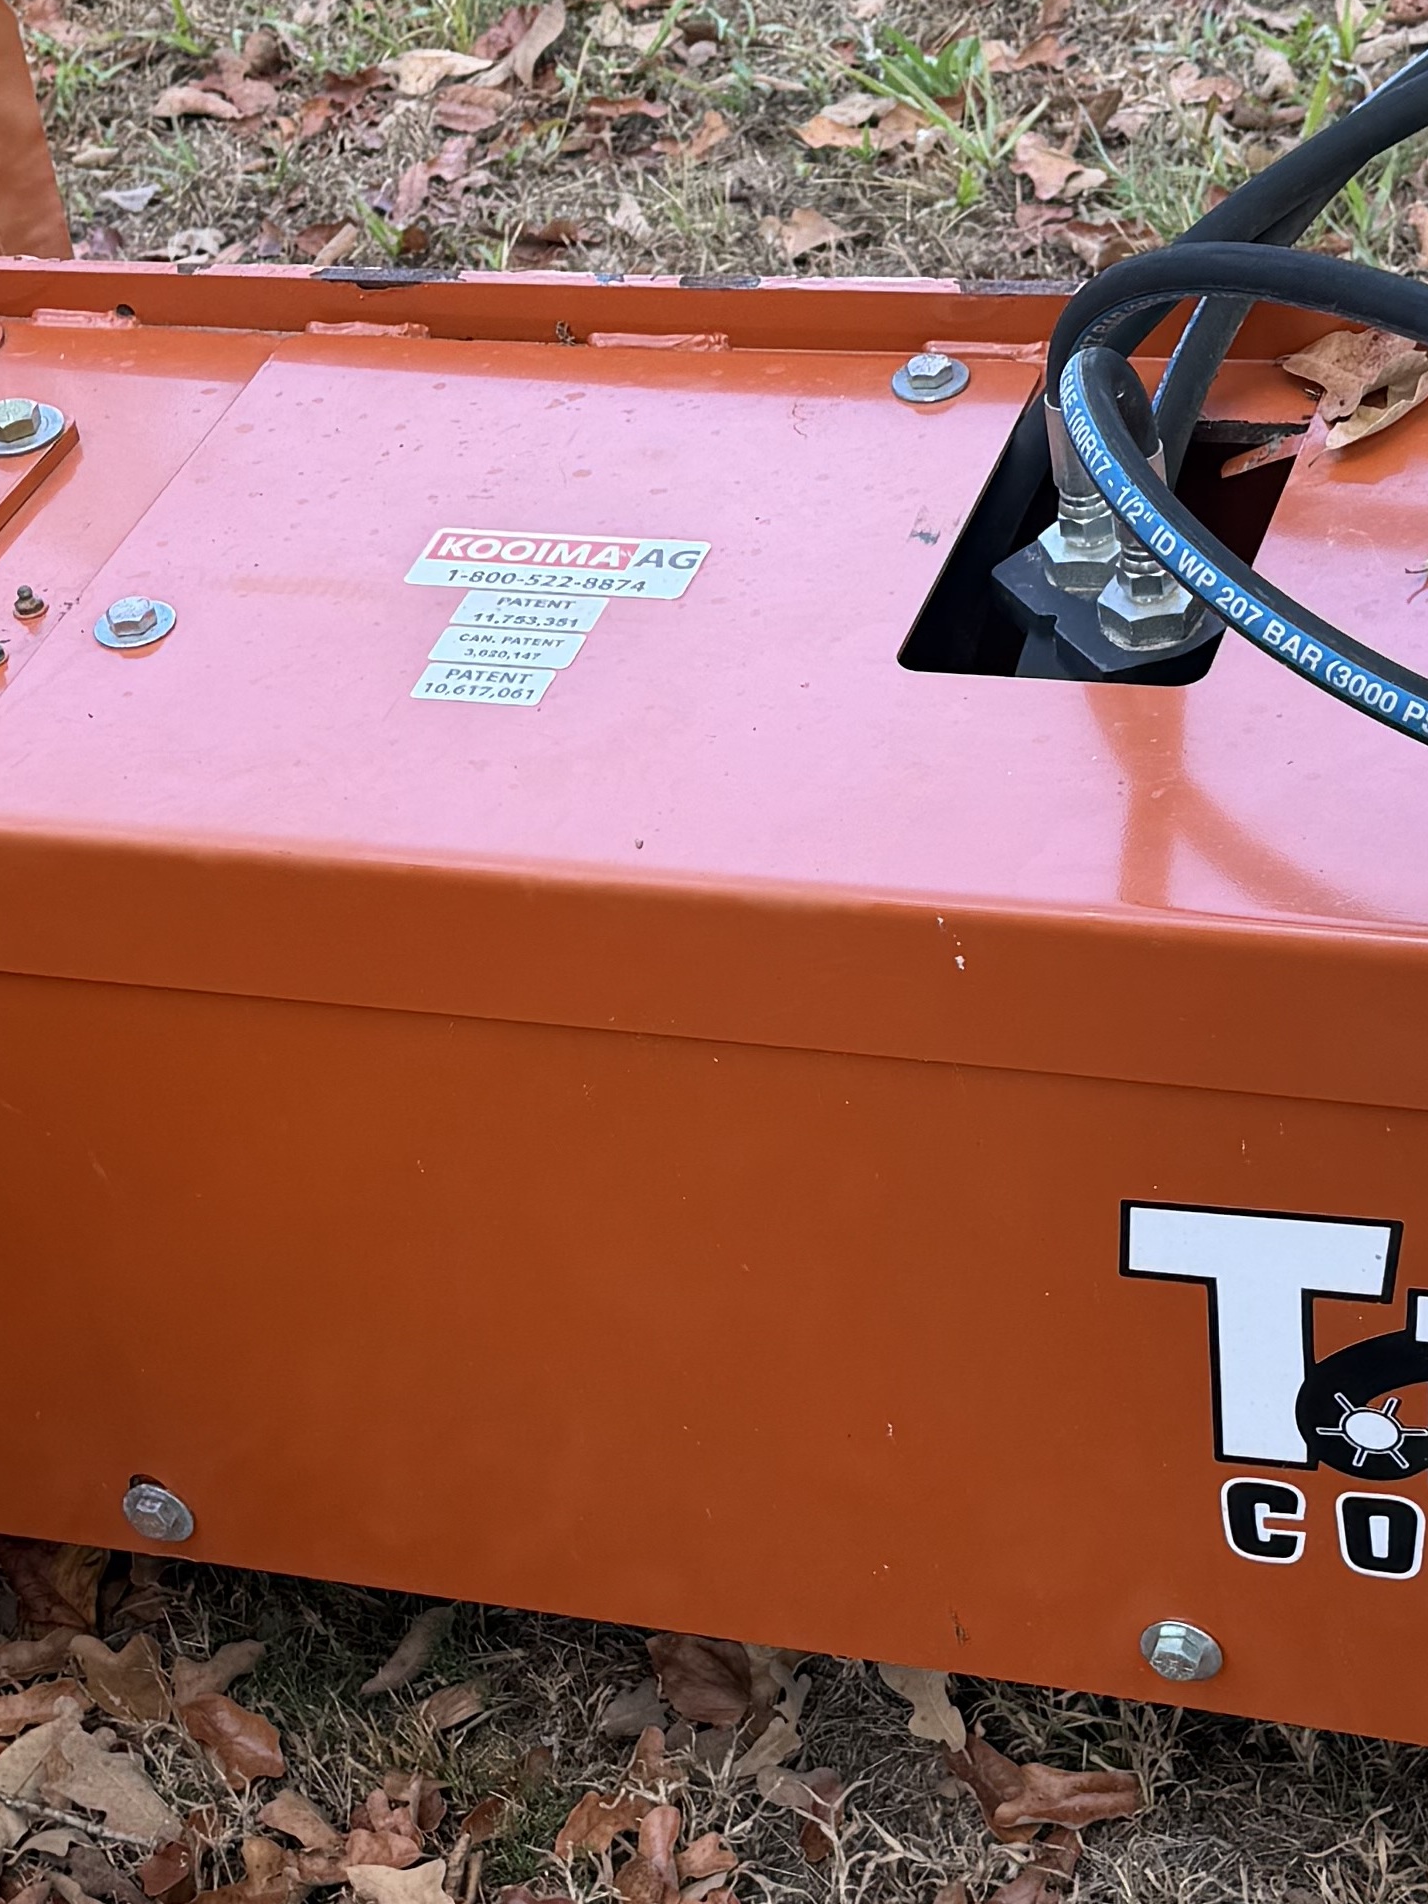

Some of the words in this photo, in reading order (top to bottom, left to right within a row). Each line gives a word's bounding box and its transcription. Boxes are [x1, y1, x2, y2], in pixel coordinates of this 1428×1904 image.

[436, 535, 623, 569] KOOIMA
[634, 548, 702, 570] AG
[1066, 407, 1113, 476] 100R17
[1116, 485, 1155, 525] 1/2"
[1149, 525, 1177, 556] ID
[1178, 548, 1217, 588] WP
[1216, 587, 1264, 626] 207
[1262, 618, 1323, 672] BAR
[1325, 660, 1399, 713] (3000
[447, 568, 647, 593] 1-800-522-8874
[497, 596, 577, 610] PATENT
[459, 633, 496, 644] CAN.
[501, 635, 565, 648] PATENT
[445, 668, 533, 685] PATENT
